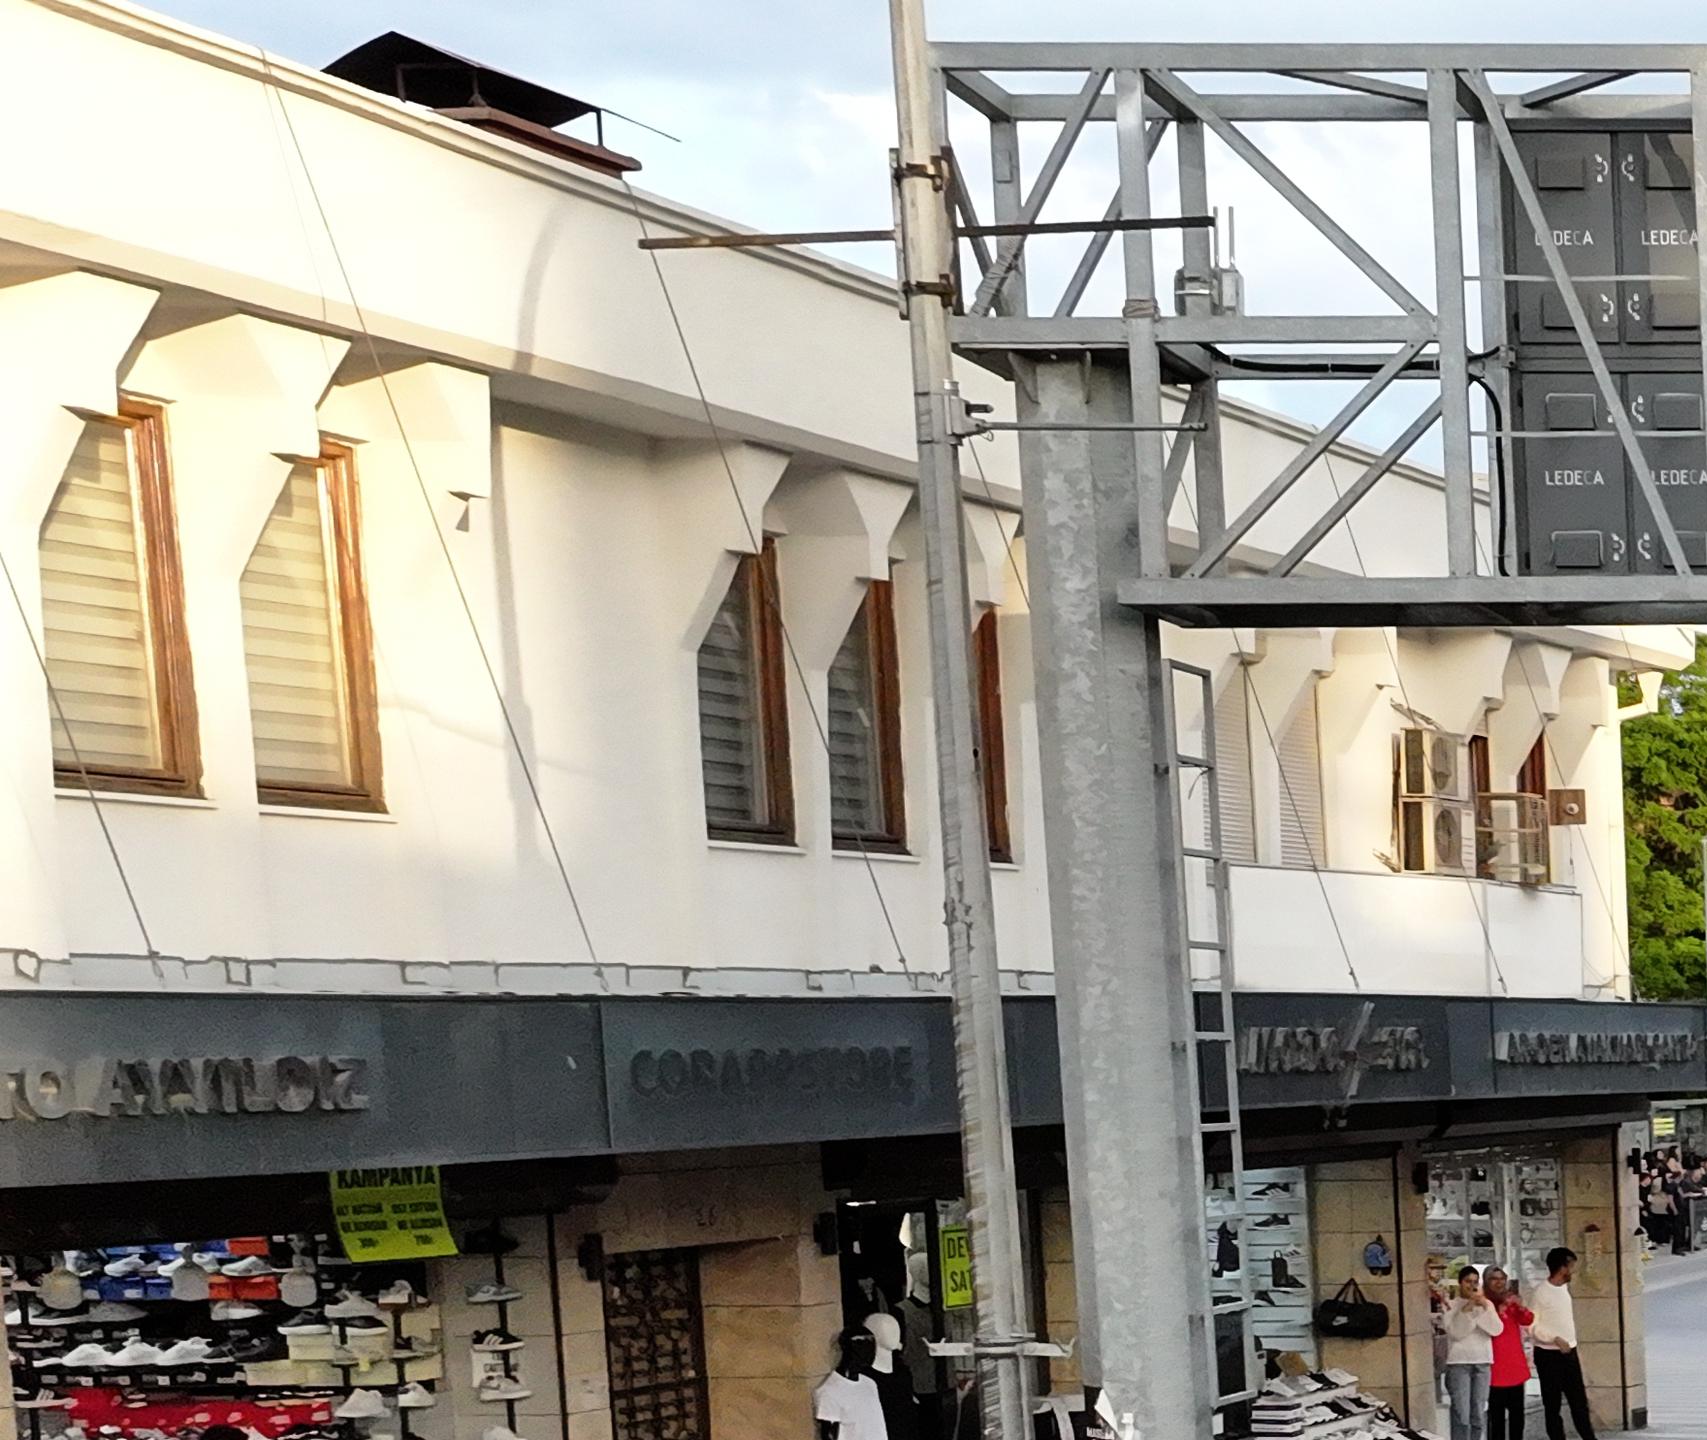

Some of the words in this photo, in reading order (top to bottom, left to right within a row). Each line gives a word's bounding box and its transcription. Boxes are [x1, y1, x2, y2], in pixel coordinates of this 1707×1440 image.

[1535, 229, 1594, 246] LDECA
[1545, 469, 1604, 486] LEDECA
[336, 1165, 436, 1189] KAMPANYA
